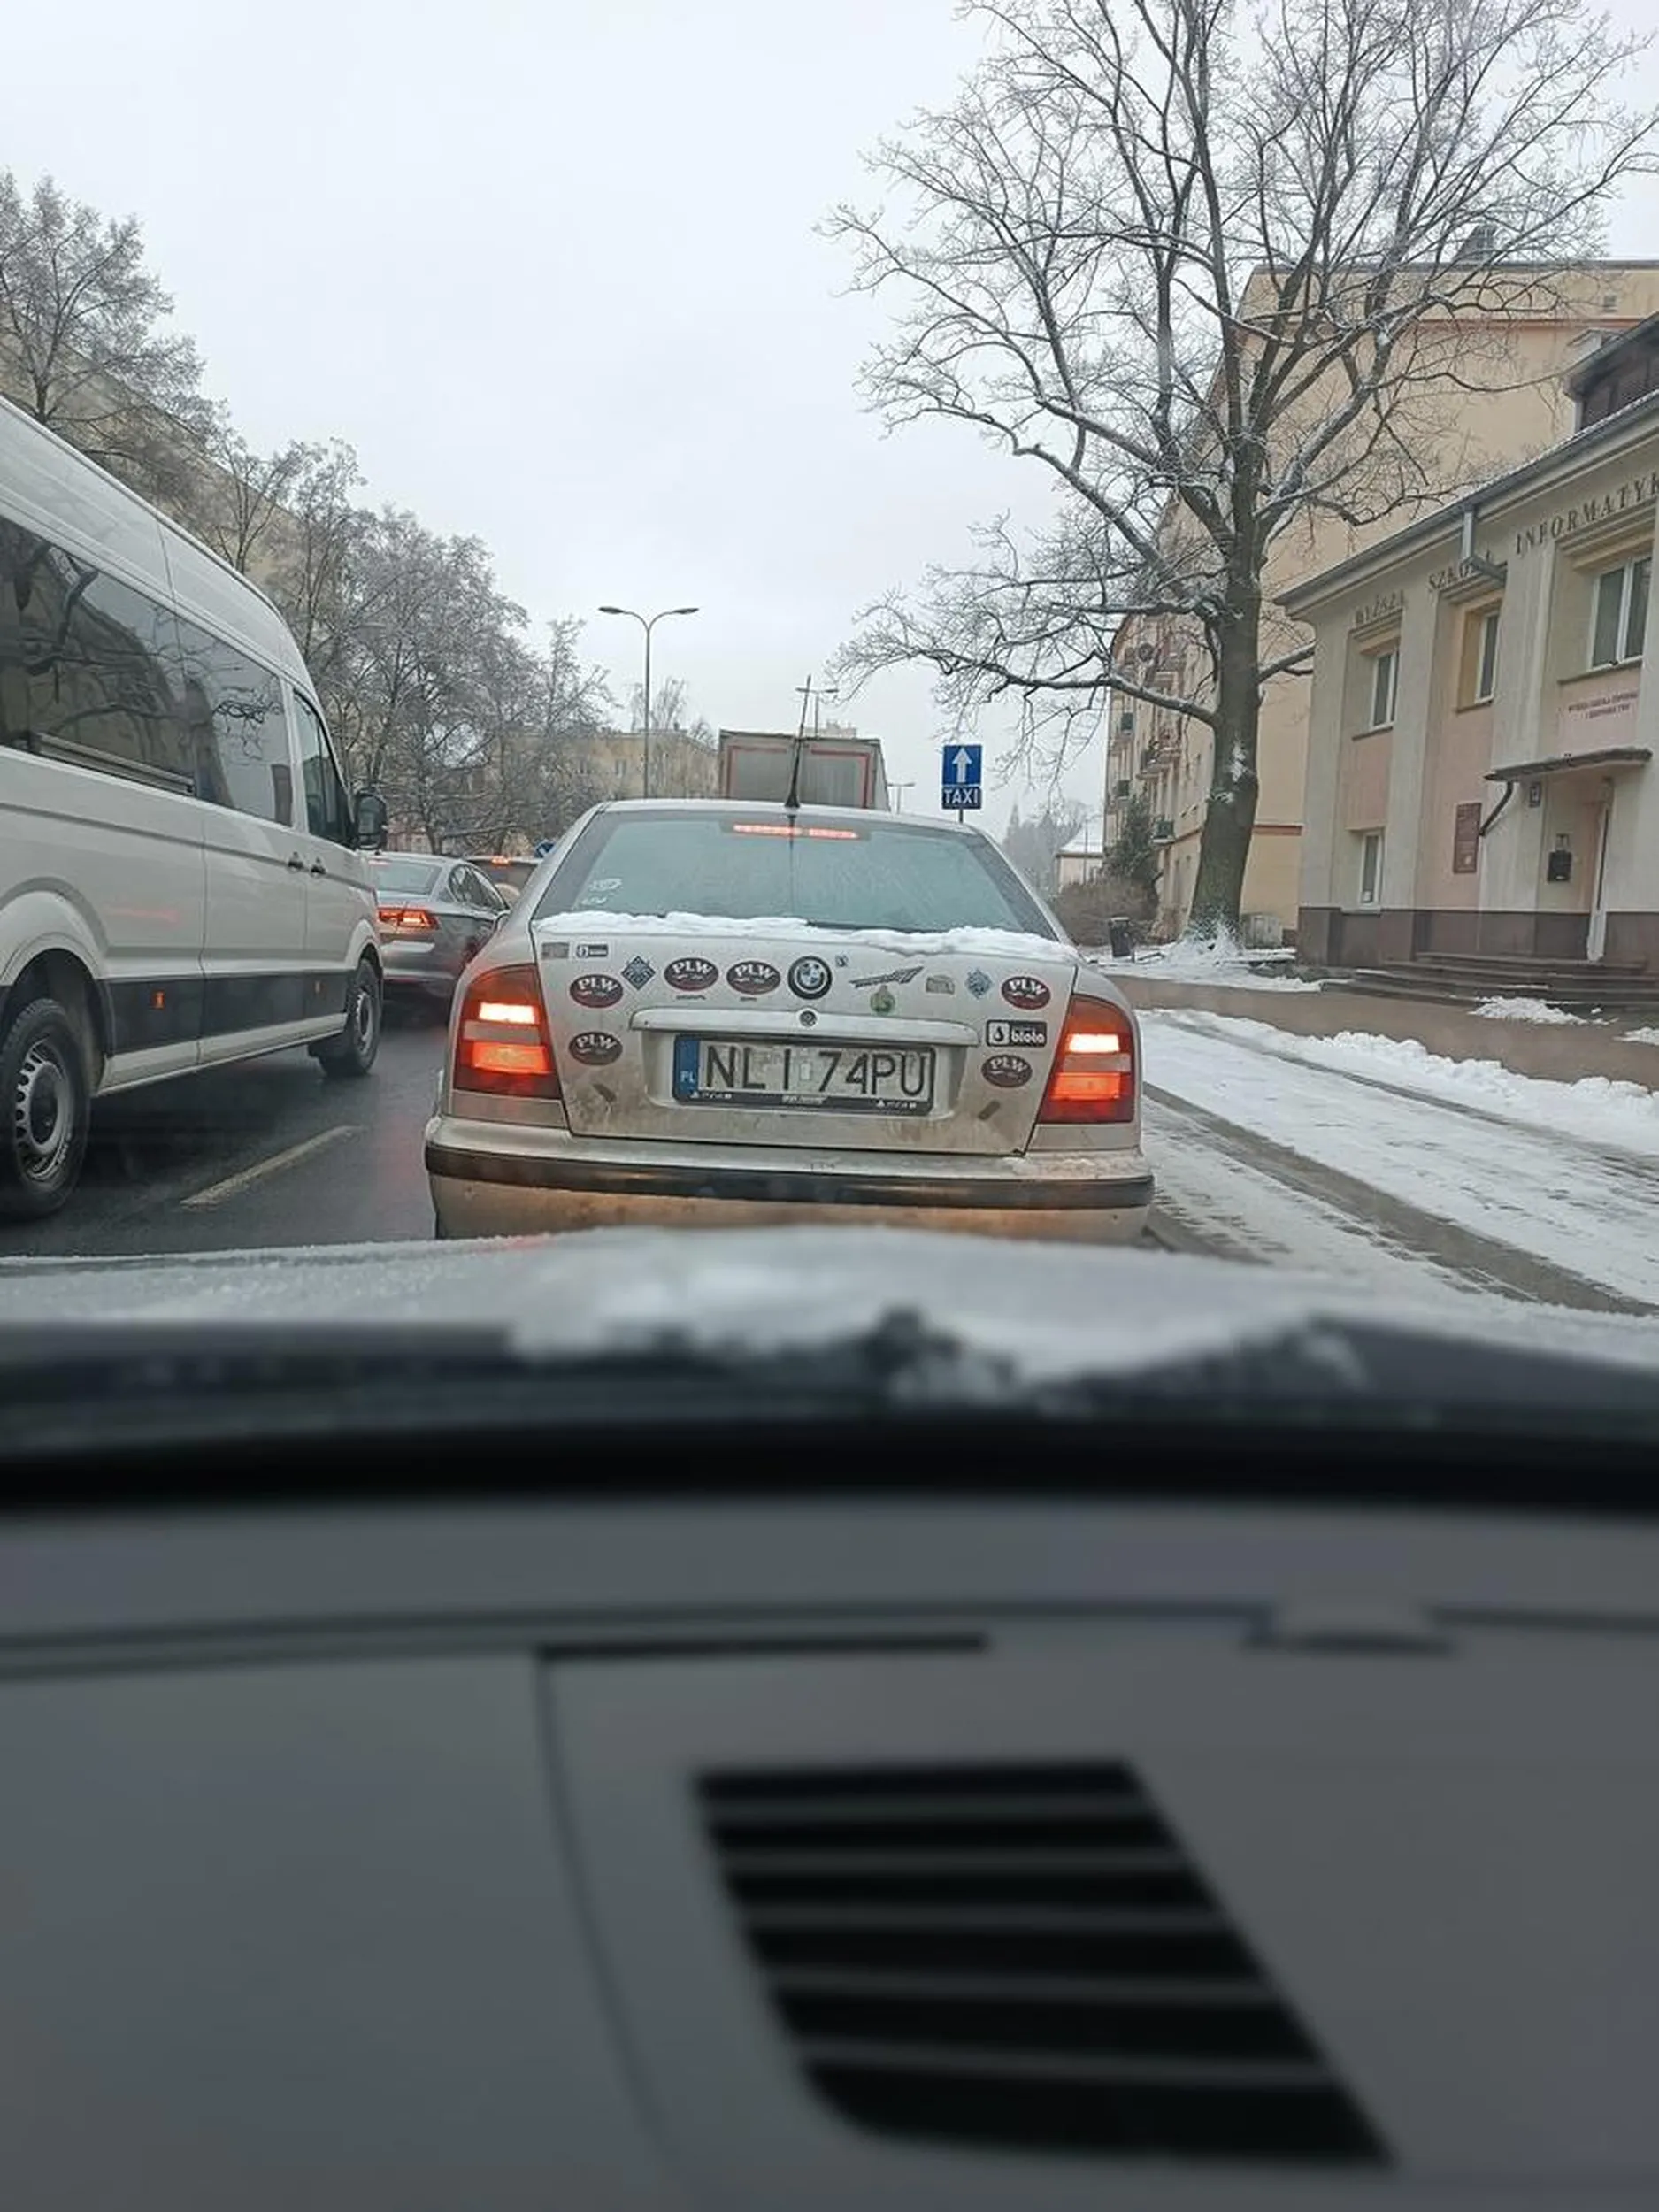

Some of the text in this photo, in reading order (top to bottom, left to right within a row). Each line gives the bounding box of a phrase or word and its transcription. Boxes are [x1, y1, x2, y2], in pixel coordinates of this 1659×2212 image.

[944, 788, 979, 804] TAXI
[672, 960, 713, 975] PLW
[735, 964, 776, 979] PLW
[578, 977, 619, 991] PLW
[1009, 979, 1046, 995] PLW
[576, 1033, 618, 1049] PLW
[991, 1056, 1028, 1074] PLW
